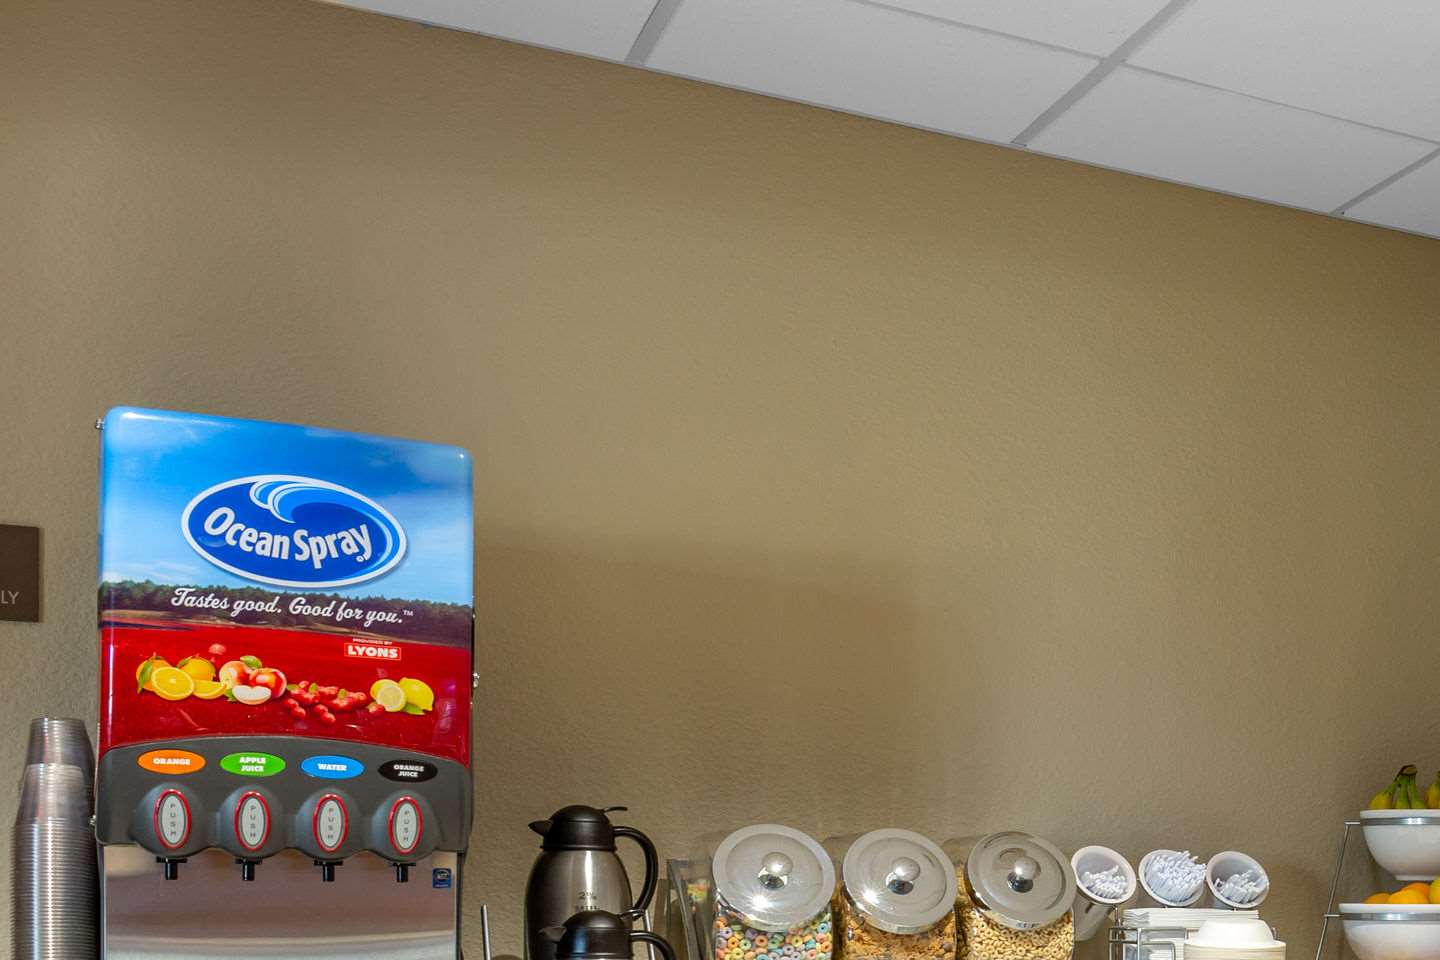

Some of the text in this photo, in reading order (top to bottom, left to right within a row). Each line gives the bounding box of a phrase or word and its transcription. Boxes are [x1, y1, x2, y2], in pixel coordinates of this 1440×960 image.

[203, 506, 372, 570] Ocean Spray
[170, 587, 230, 609] Tastes
[230, 596, 282, 617] good.
[288, 597, 334, 617] Good
[335, 602, 363, 621] for
[347, 645, 398, 658] LYONS
[317, 763, 347, 771] WATER
[393, 764, 424, 772] ORANGE
